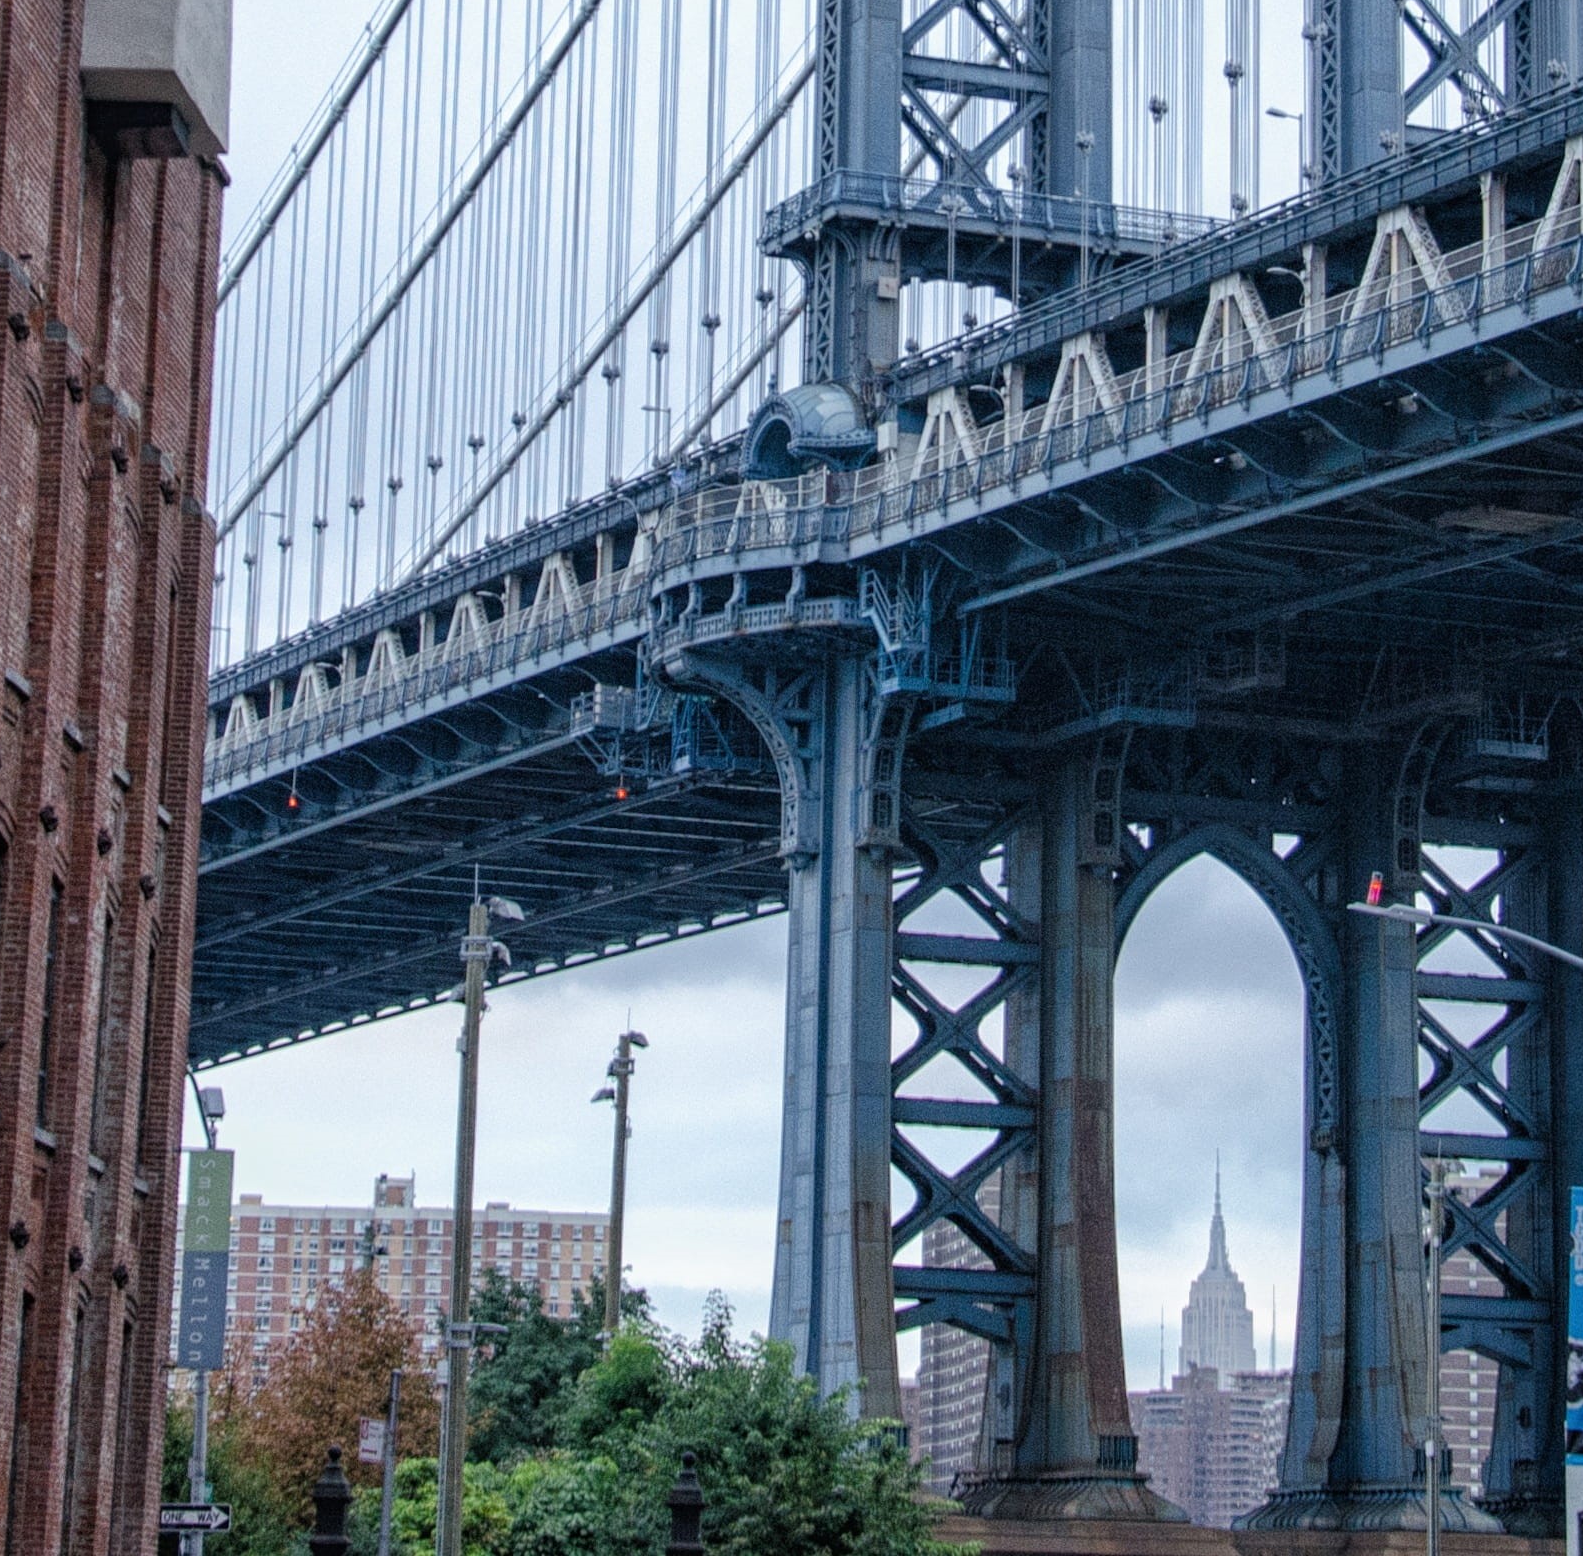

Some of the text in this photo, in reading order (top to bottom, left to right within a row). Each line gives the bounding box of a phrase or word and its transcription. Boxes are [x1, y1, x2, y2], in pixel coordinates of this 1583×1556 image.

[188, 1158, 215, 1362] Smack Mellon
[163, 1512, 220, 1522] ONE WAY
